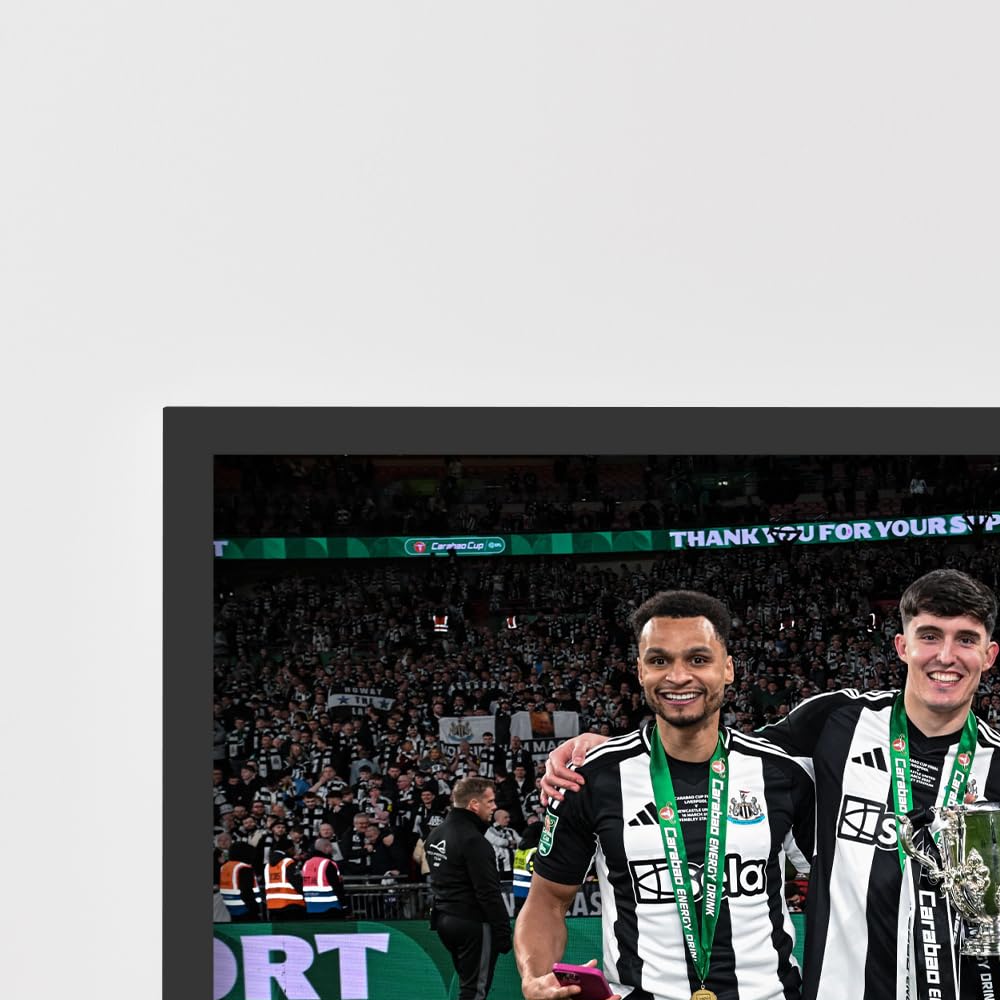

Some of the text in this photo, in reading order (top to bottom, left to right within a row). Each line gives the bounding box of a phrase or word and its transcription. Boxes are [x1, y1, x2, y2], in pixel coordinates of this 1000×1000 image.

[669, 528, 760, 548] THANK
[819, 522, 872, 541] FOR
[875, 516, 947, 538] YOUR
[894, 757, 909, 814] Carabao
[663, 827, 684, 886] Carabao
[676, 888, 693, 931] ENERGY
[704, 778, 725, 918] Carabao ENERGY DRINK
[918, 889, 941, 985] Carabao
